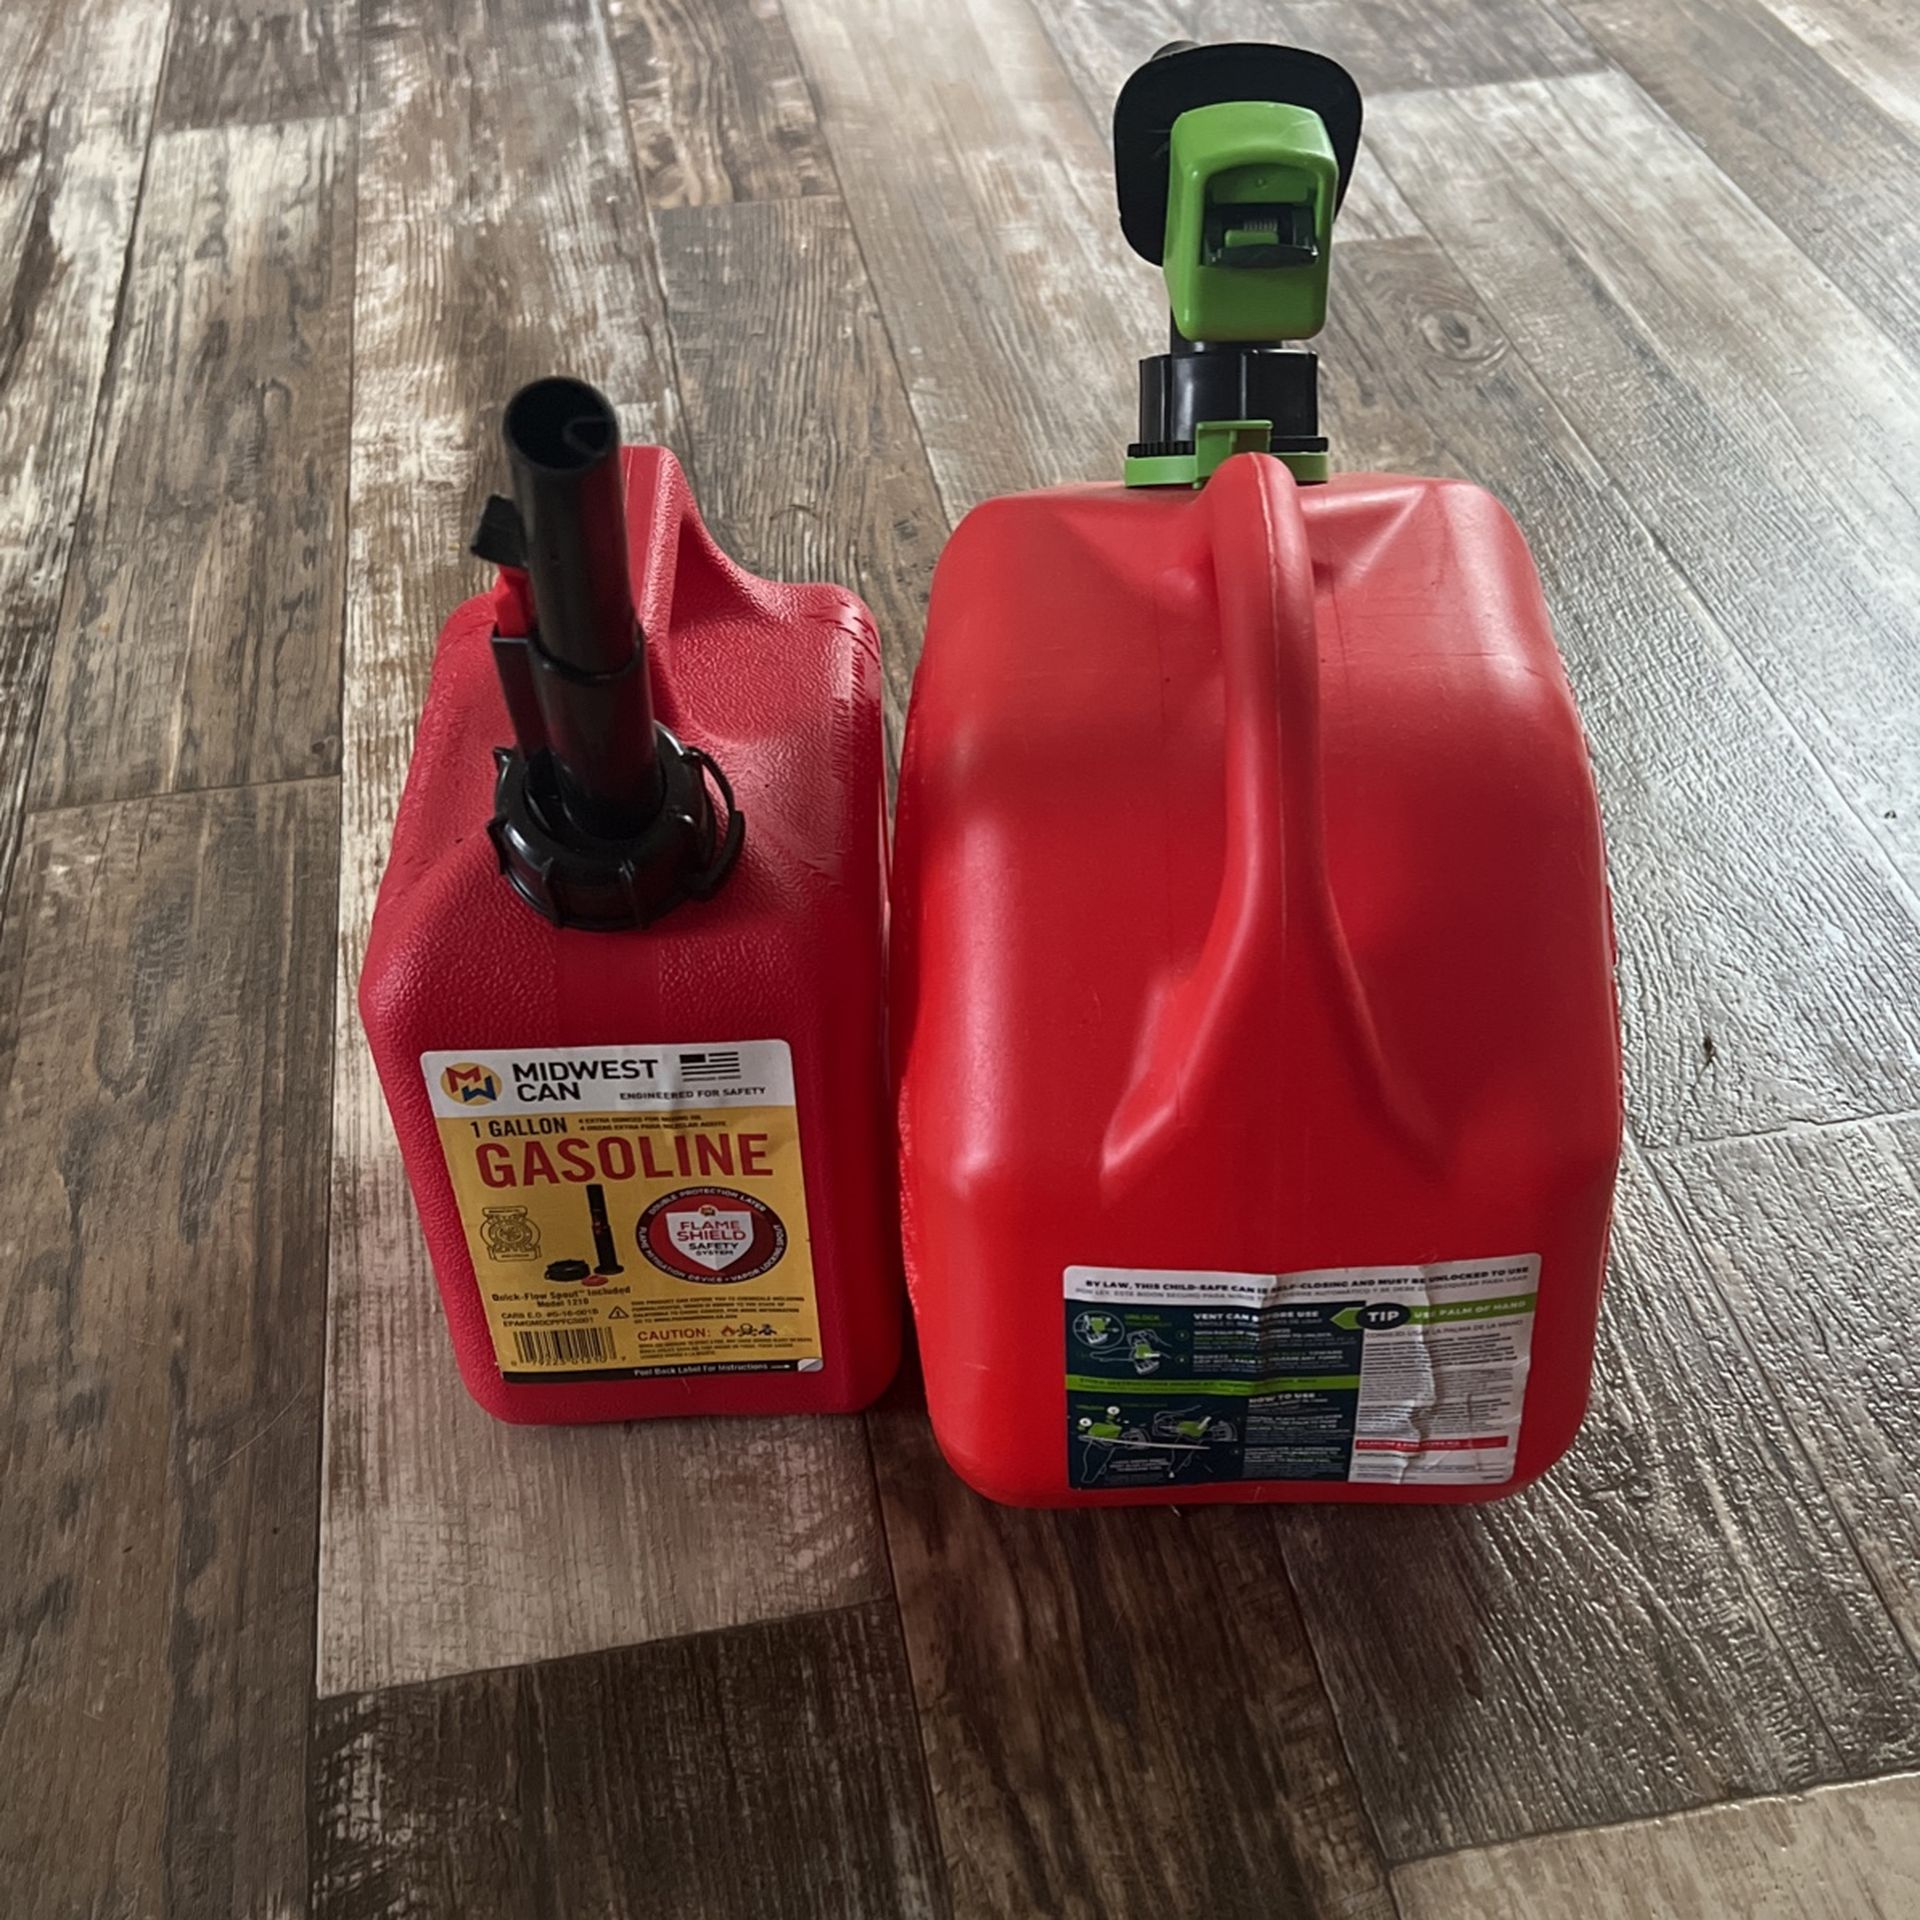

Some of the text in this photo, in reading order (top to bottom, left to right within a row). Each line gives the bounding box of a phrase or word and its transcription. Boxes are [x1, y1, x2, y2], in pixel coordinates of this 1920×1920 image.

[512, 1059, 659, 1082] MIDWEST
[517, 1082, 581, 1102] CAN
[620, 1087, 766, 1100] ENGINEERED FOR SAFETY
[470, 1117, 568, 1138] 1 GALLON
[474, 1133, 774, 1189] GASOLINE
[680, 1187, 739, 1198] PROTECTION
[740, 1195, 767, 1213] LAYER
[680, 1221, 740, 1230] FLAME
[676, 1230, 747, 1241] SHIELD
[688, 1242, 739, 1250] SAFETY
[1103, 1281, 1133, 1289] LAW,
[1231, 1285, 1255, 1293] CAN
[1257, 1286, 1268, 1294] IS
[1351, 1278, 1376, 1286] AND
[1377, 1277, 1409, 1286] MUST
[1412, 1277, 1426, 1285] BE
[1428, 1270, 1489, 1282] UNLOCKED
[1491, 1269, 1506, 1277] TO
[1508, 1266, 1529, 1274] USE
[588, 1286, 631, 1297] Included
[537, 1299, 565, 1308] Model
[1193, 1312, 1224, 1321] VENT
[1226, 1313, 1250, 1321] CAN
[1297, 1310, 1320, 1318] USE
[1367, 1310, 1400, 1322] TIP
[1439, 1306, 1472, 1317] PALM
[1475, 1305, 1490, 1314] OF
[637, 1327, 712, 1342] CAUTION:
[654, 1367, 676, 1376] Back
[678, 1366, 701, 1375] Label
[718, 1363, 769, 1372] Instructions
